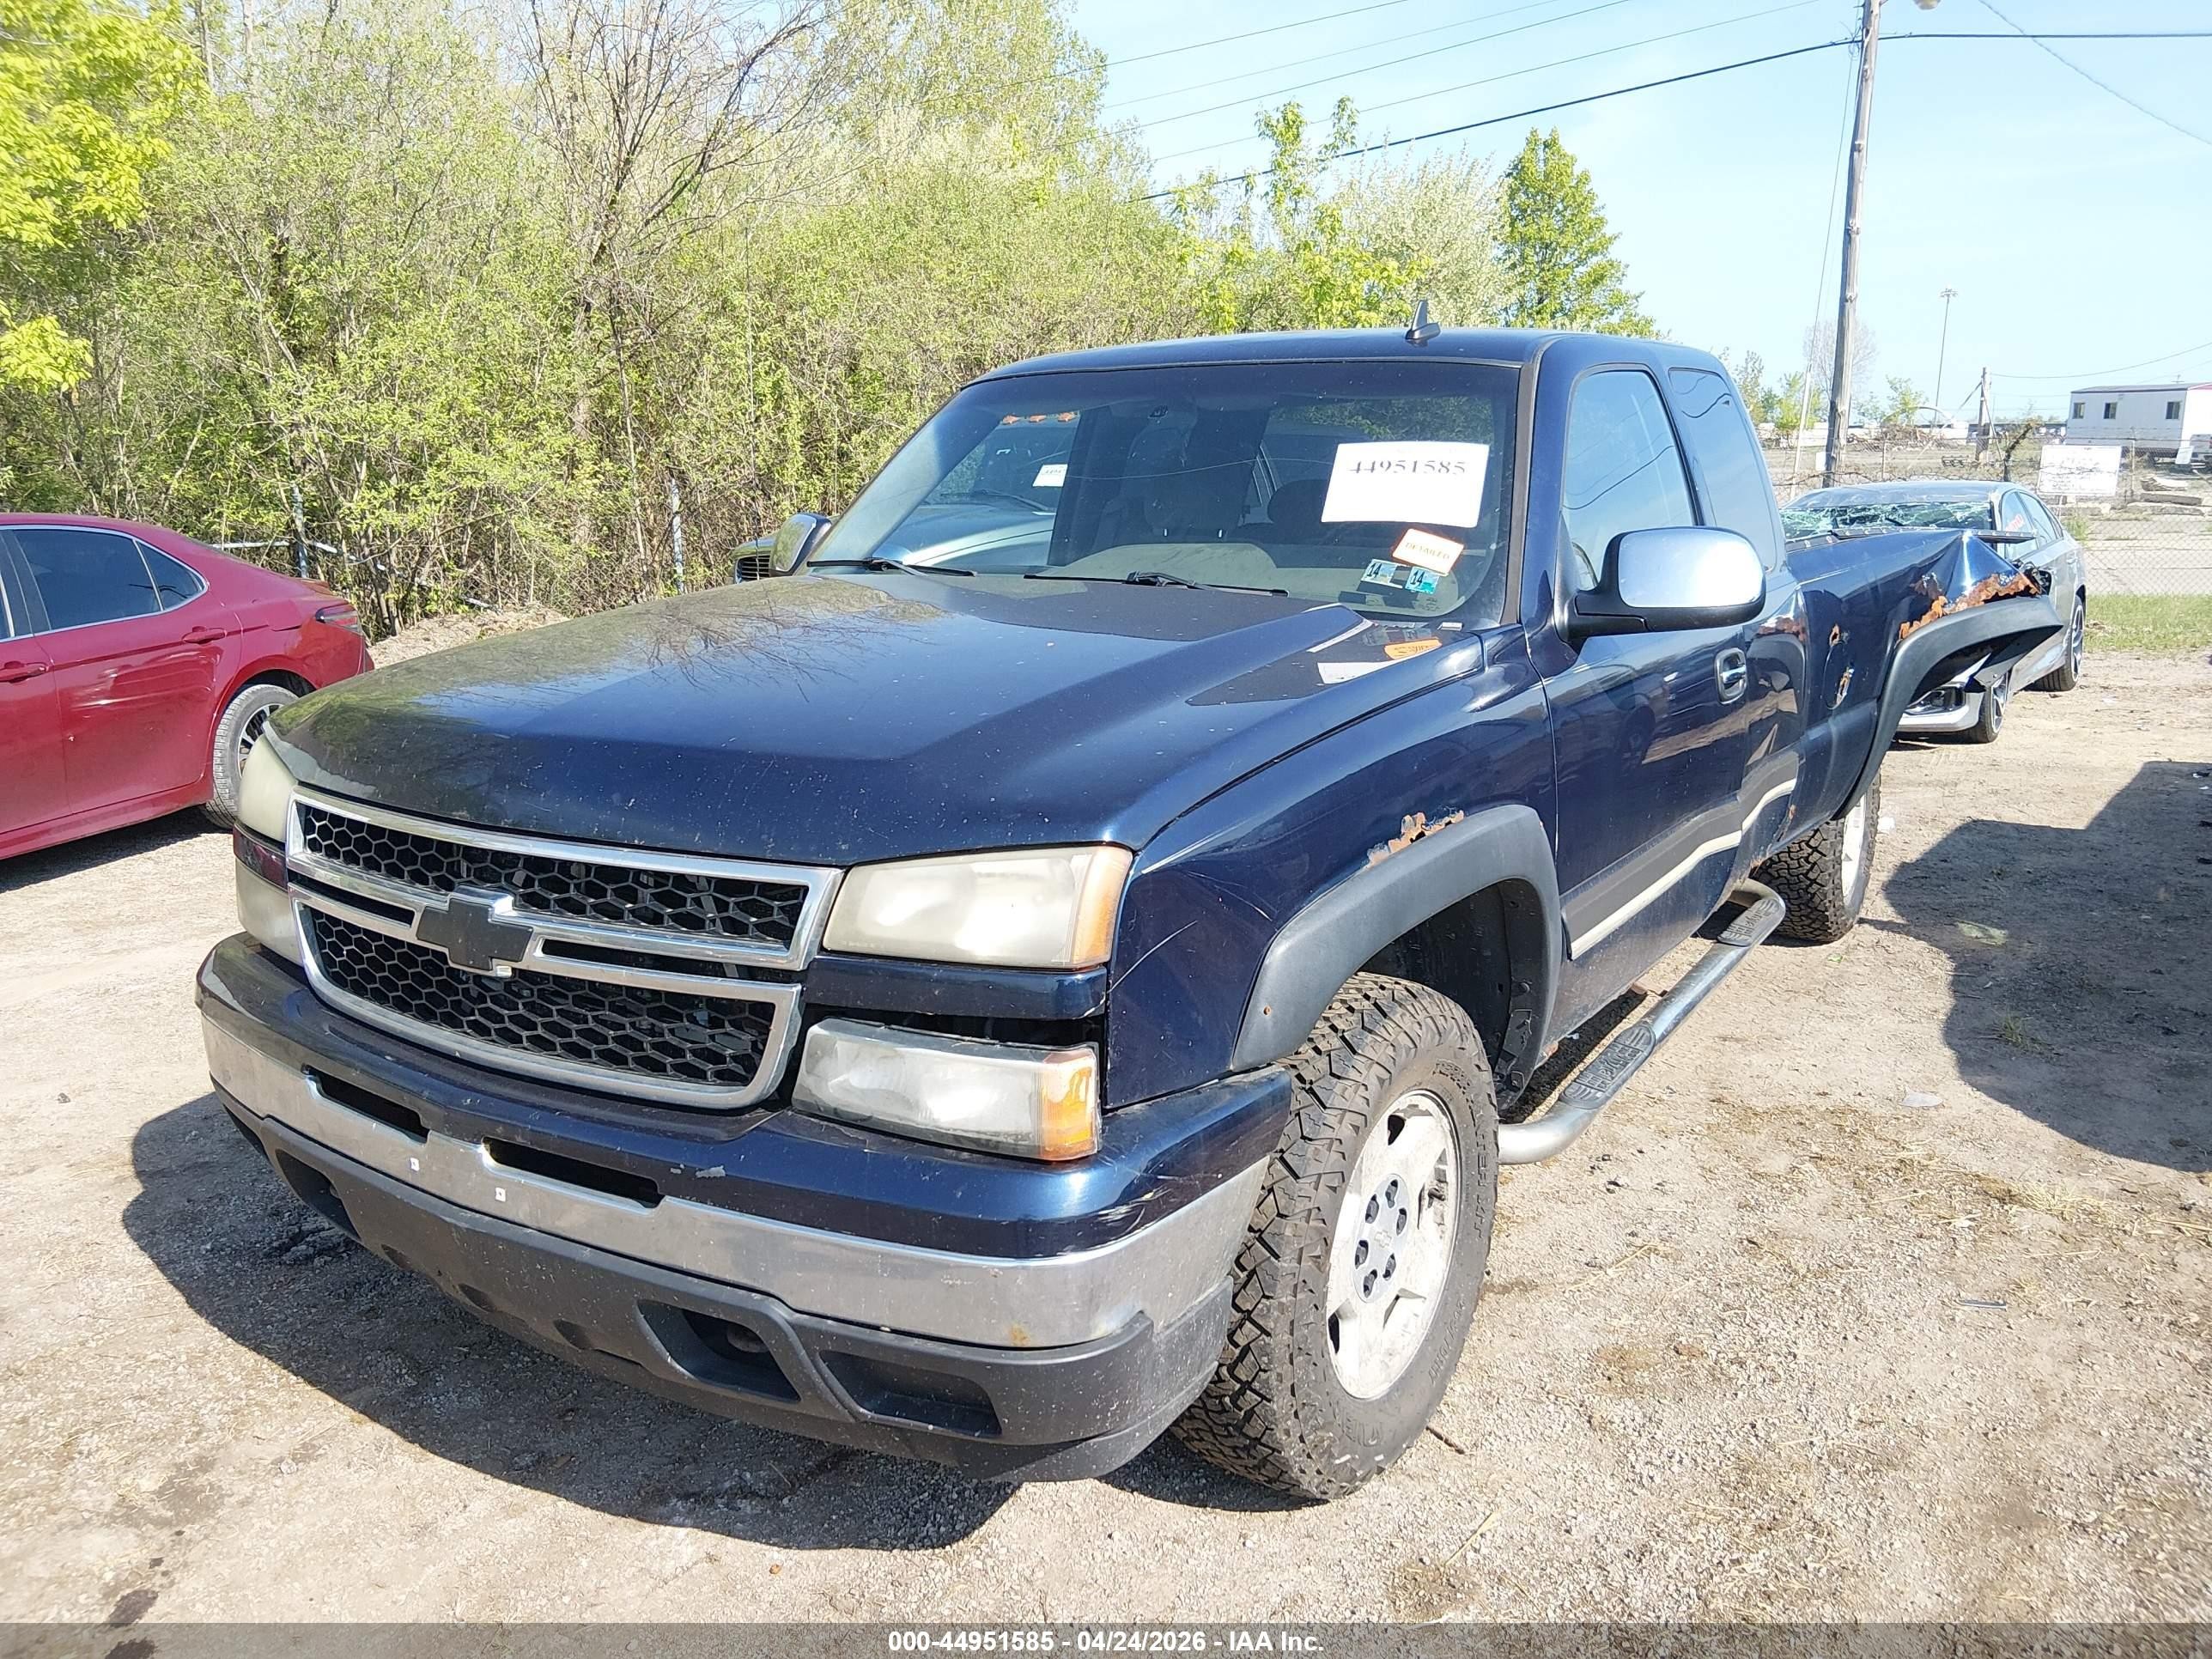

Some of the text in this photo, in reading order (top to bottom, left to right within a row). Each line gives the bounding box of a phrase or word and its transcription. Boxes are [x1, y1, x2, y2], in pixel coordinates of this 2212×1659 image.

[1346, 459, 1466, 476] 44951585
[1366, 562, 1382, 578] 14
[1410, 569, 1425, 586] 14
